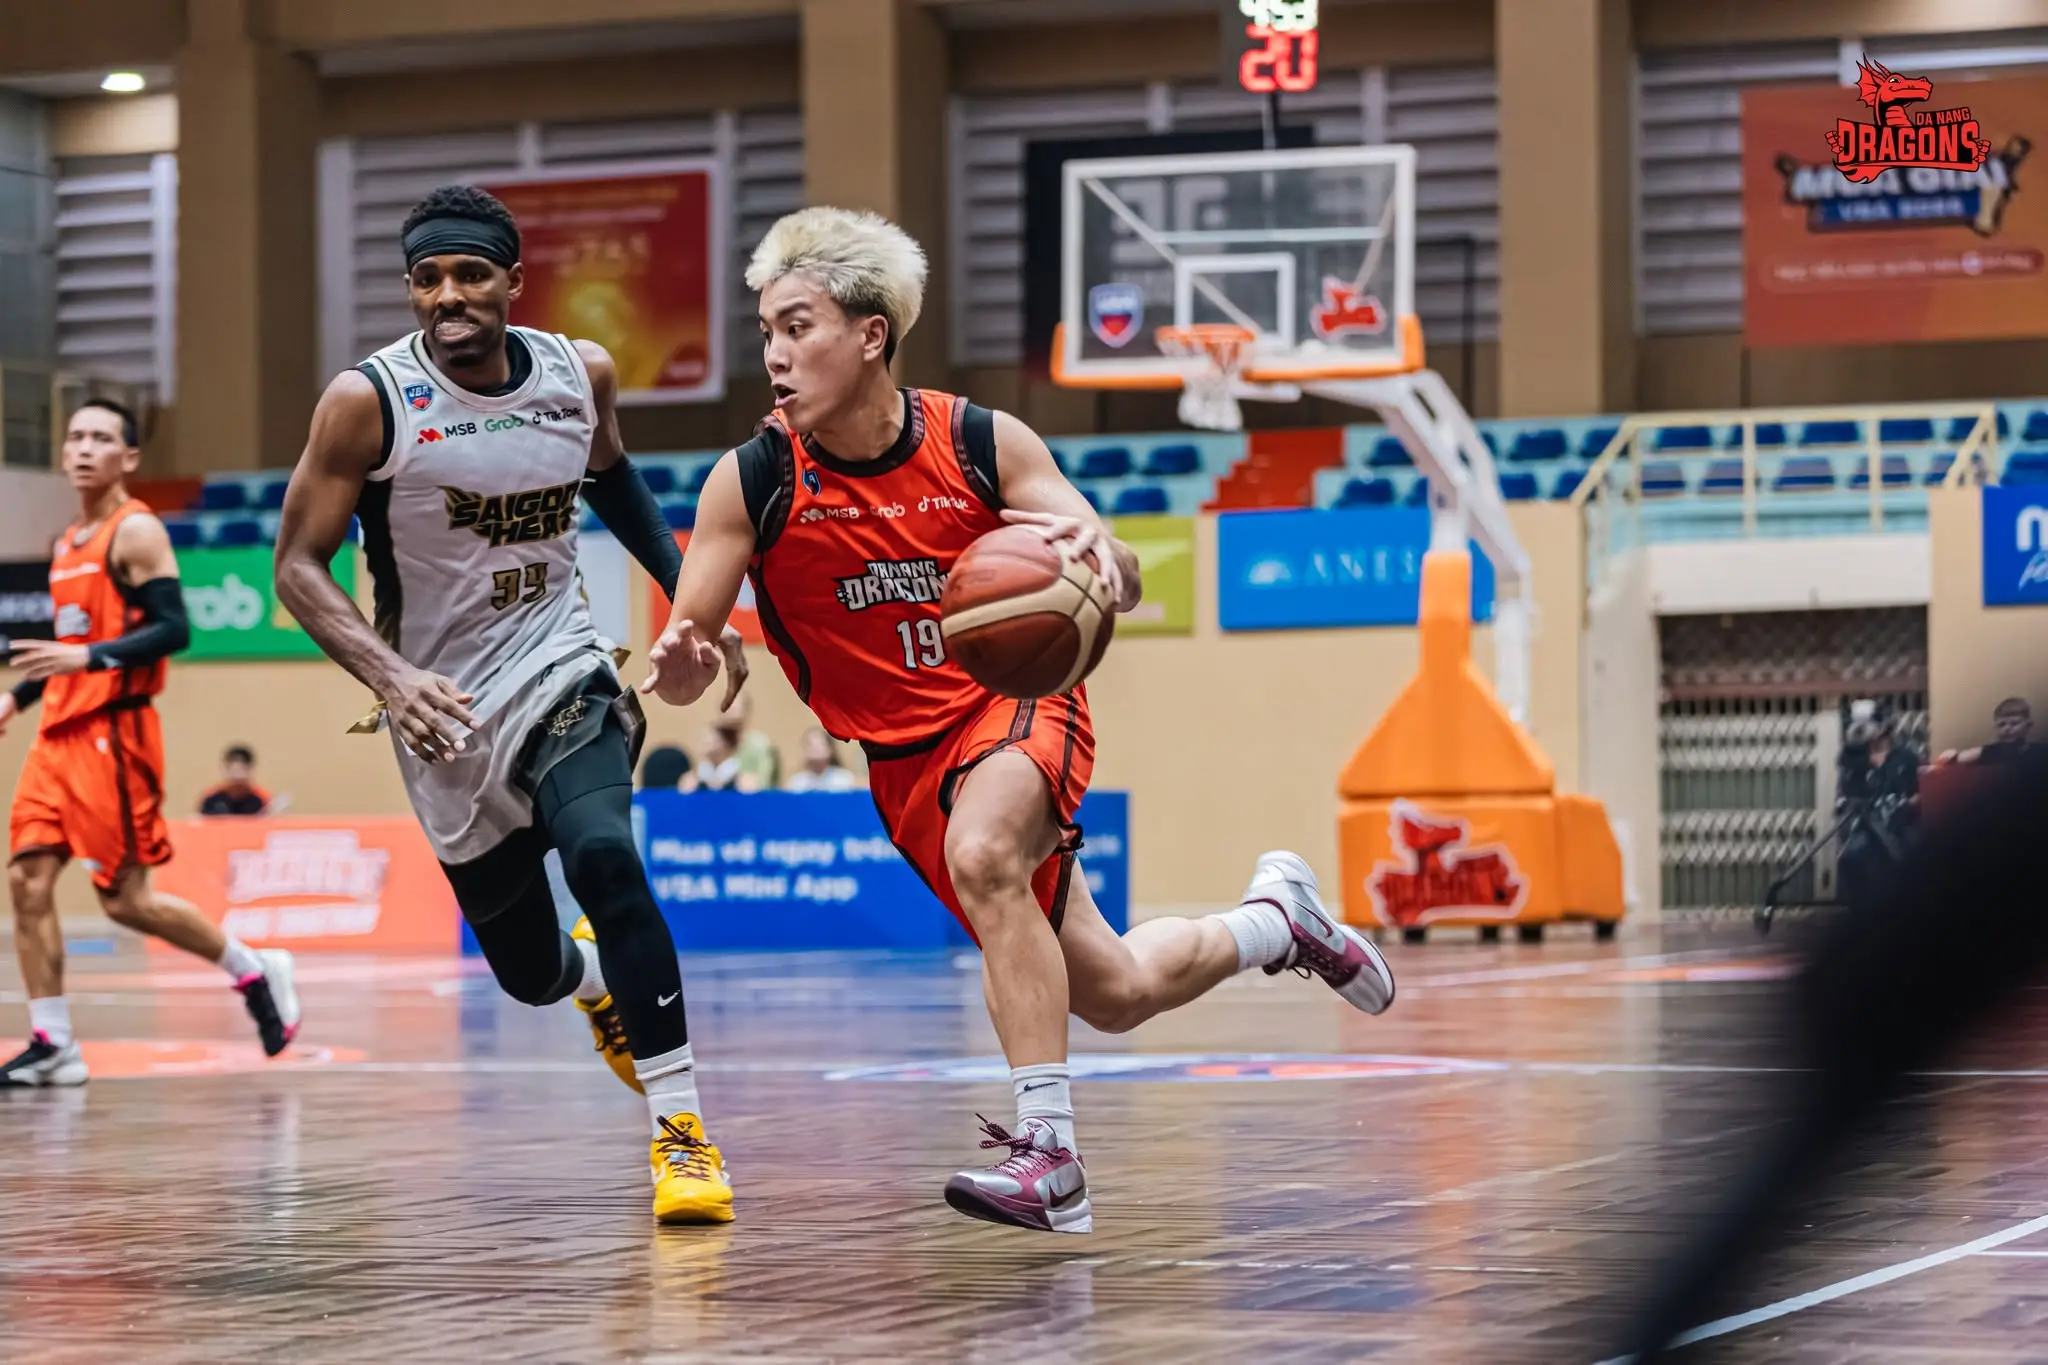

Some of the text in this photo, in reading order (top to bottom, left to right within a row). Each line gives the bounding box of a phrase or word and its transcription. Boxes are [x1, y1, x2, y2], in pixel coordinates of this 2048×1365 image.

[1239, 23, 1318, 92] 20
[444, 422, 477, 438] MSB
[543, 407, 583, 422] TikTok
[826, 506, 860, 519] MSB
[842, 572, 947, 610] DRAGON
[896, 618, 946, 669] 19
